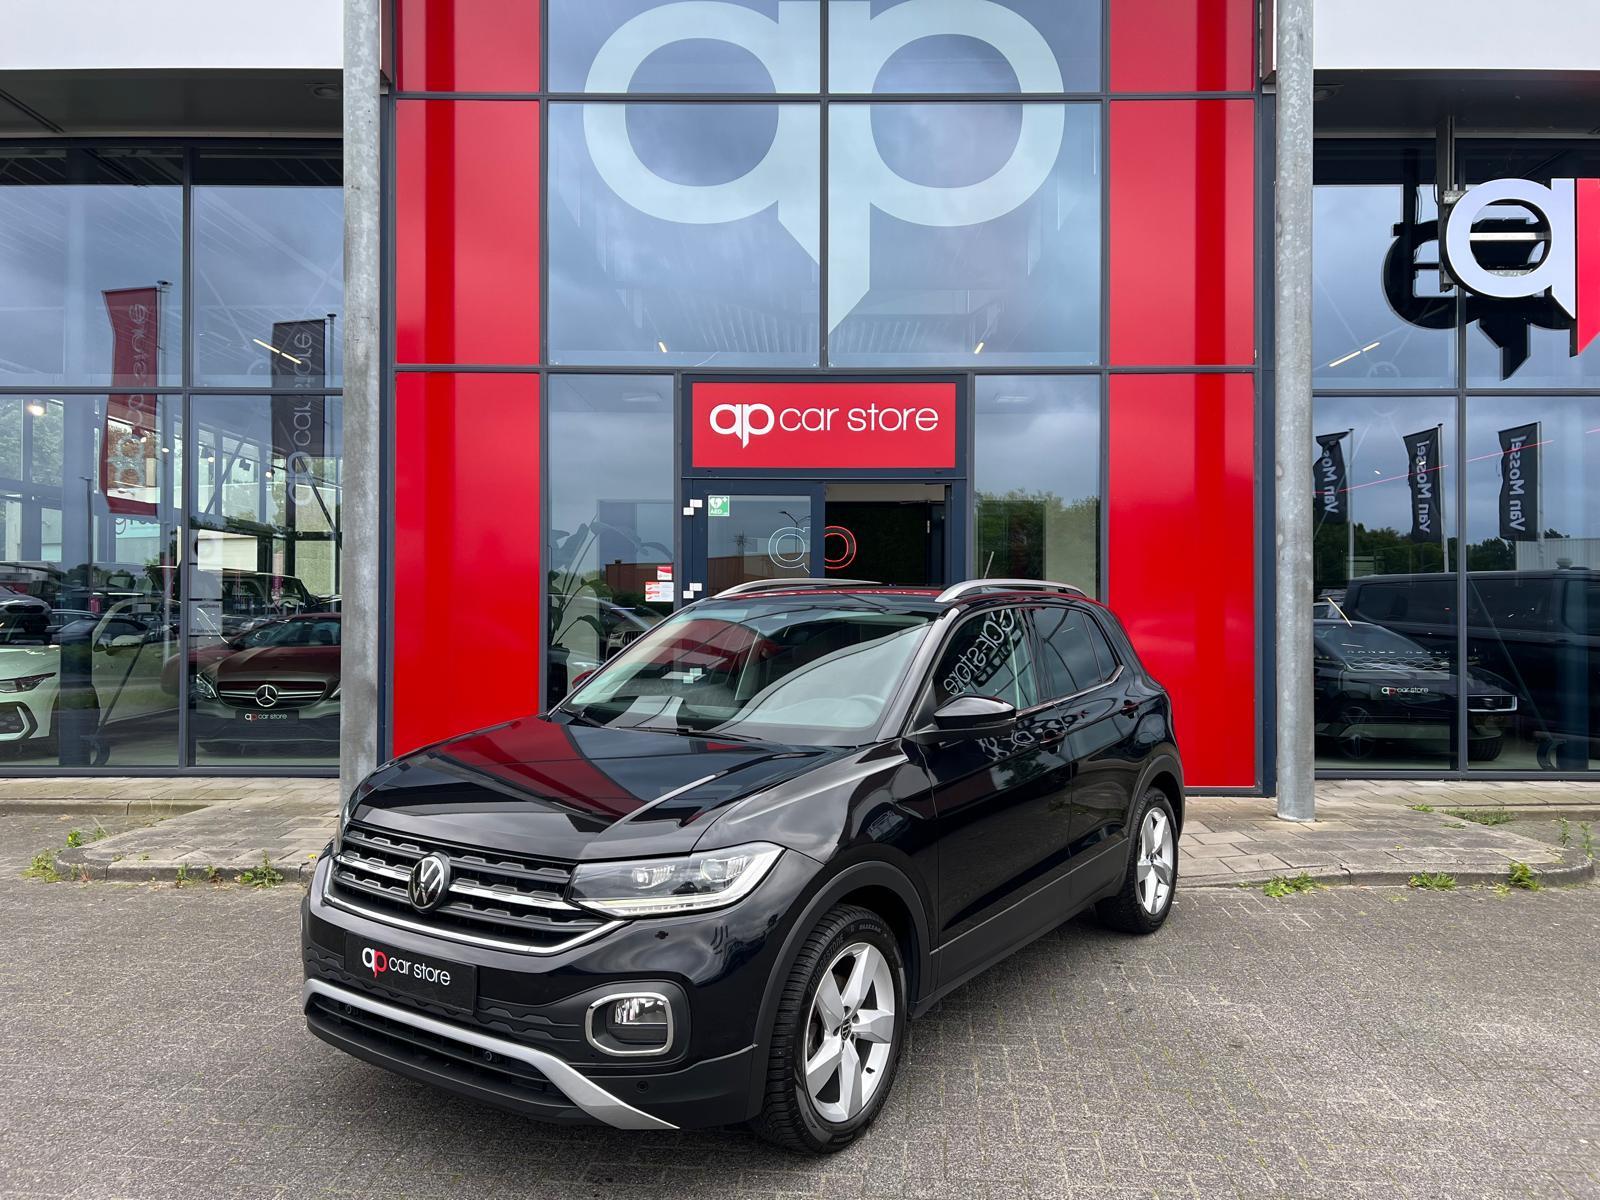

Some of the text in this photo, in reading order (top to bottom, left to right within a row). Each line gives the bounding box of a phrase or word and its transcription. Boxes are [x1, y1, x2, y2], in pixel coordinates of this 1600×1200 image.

[779, 407, 839, 431] car
[847, 403, 939, 431] store
[389, 957, 411, 975] car
[413, 963, 450, 985] store
